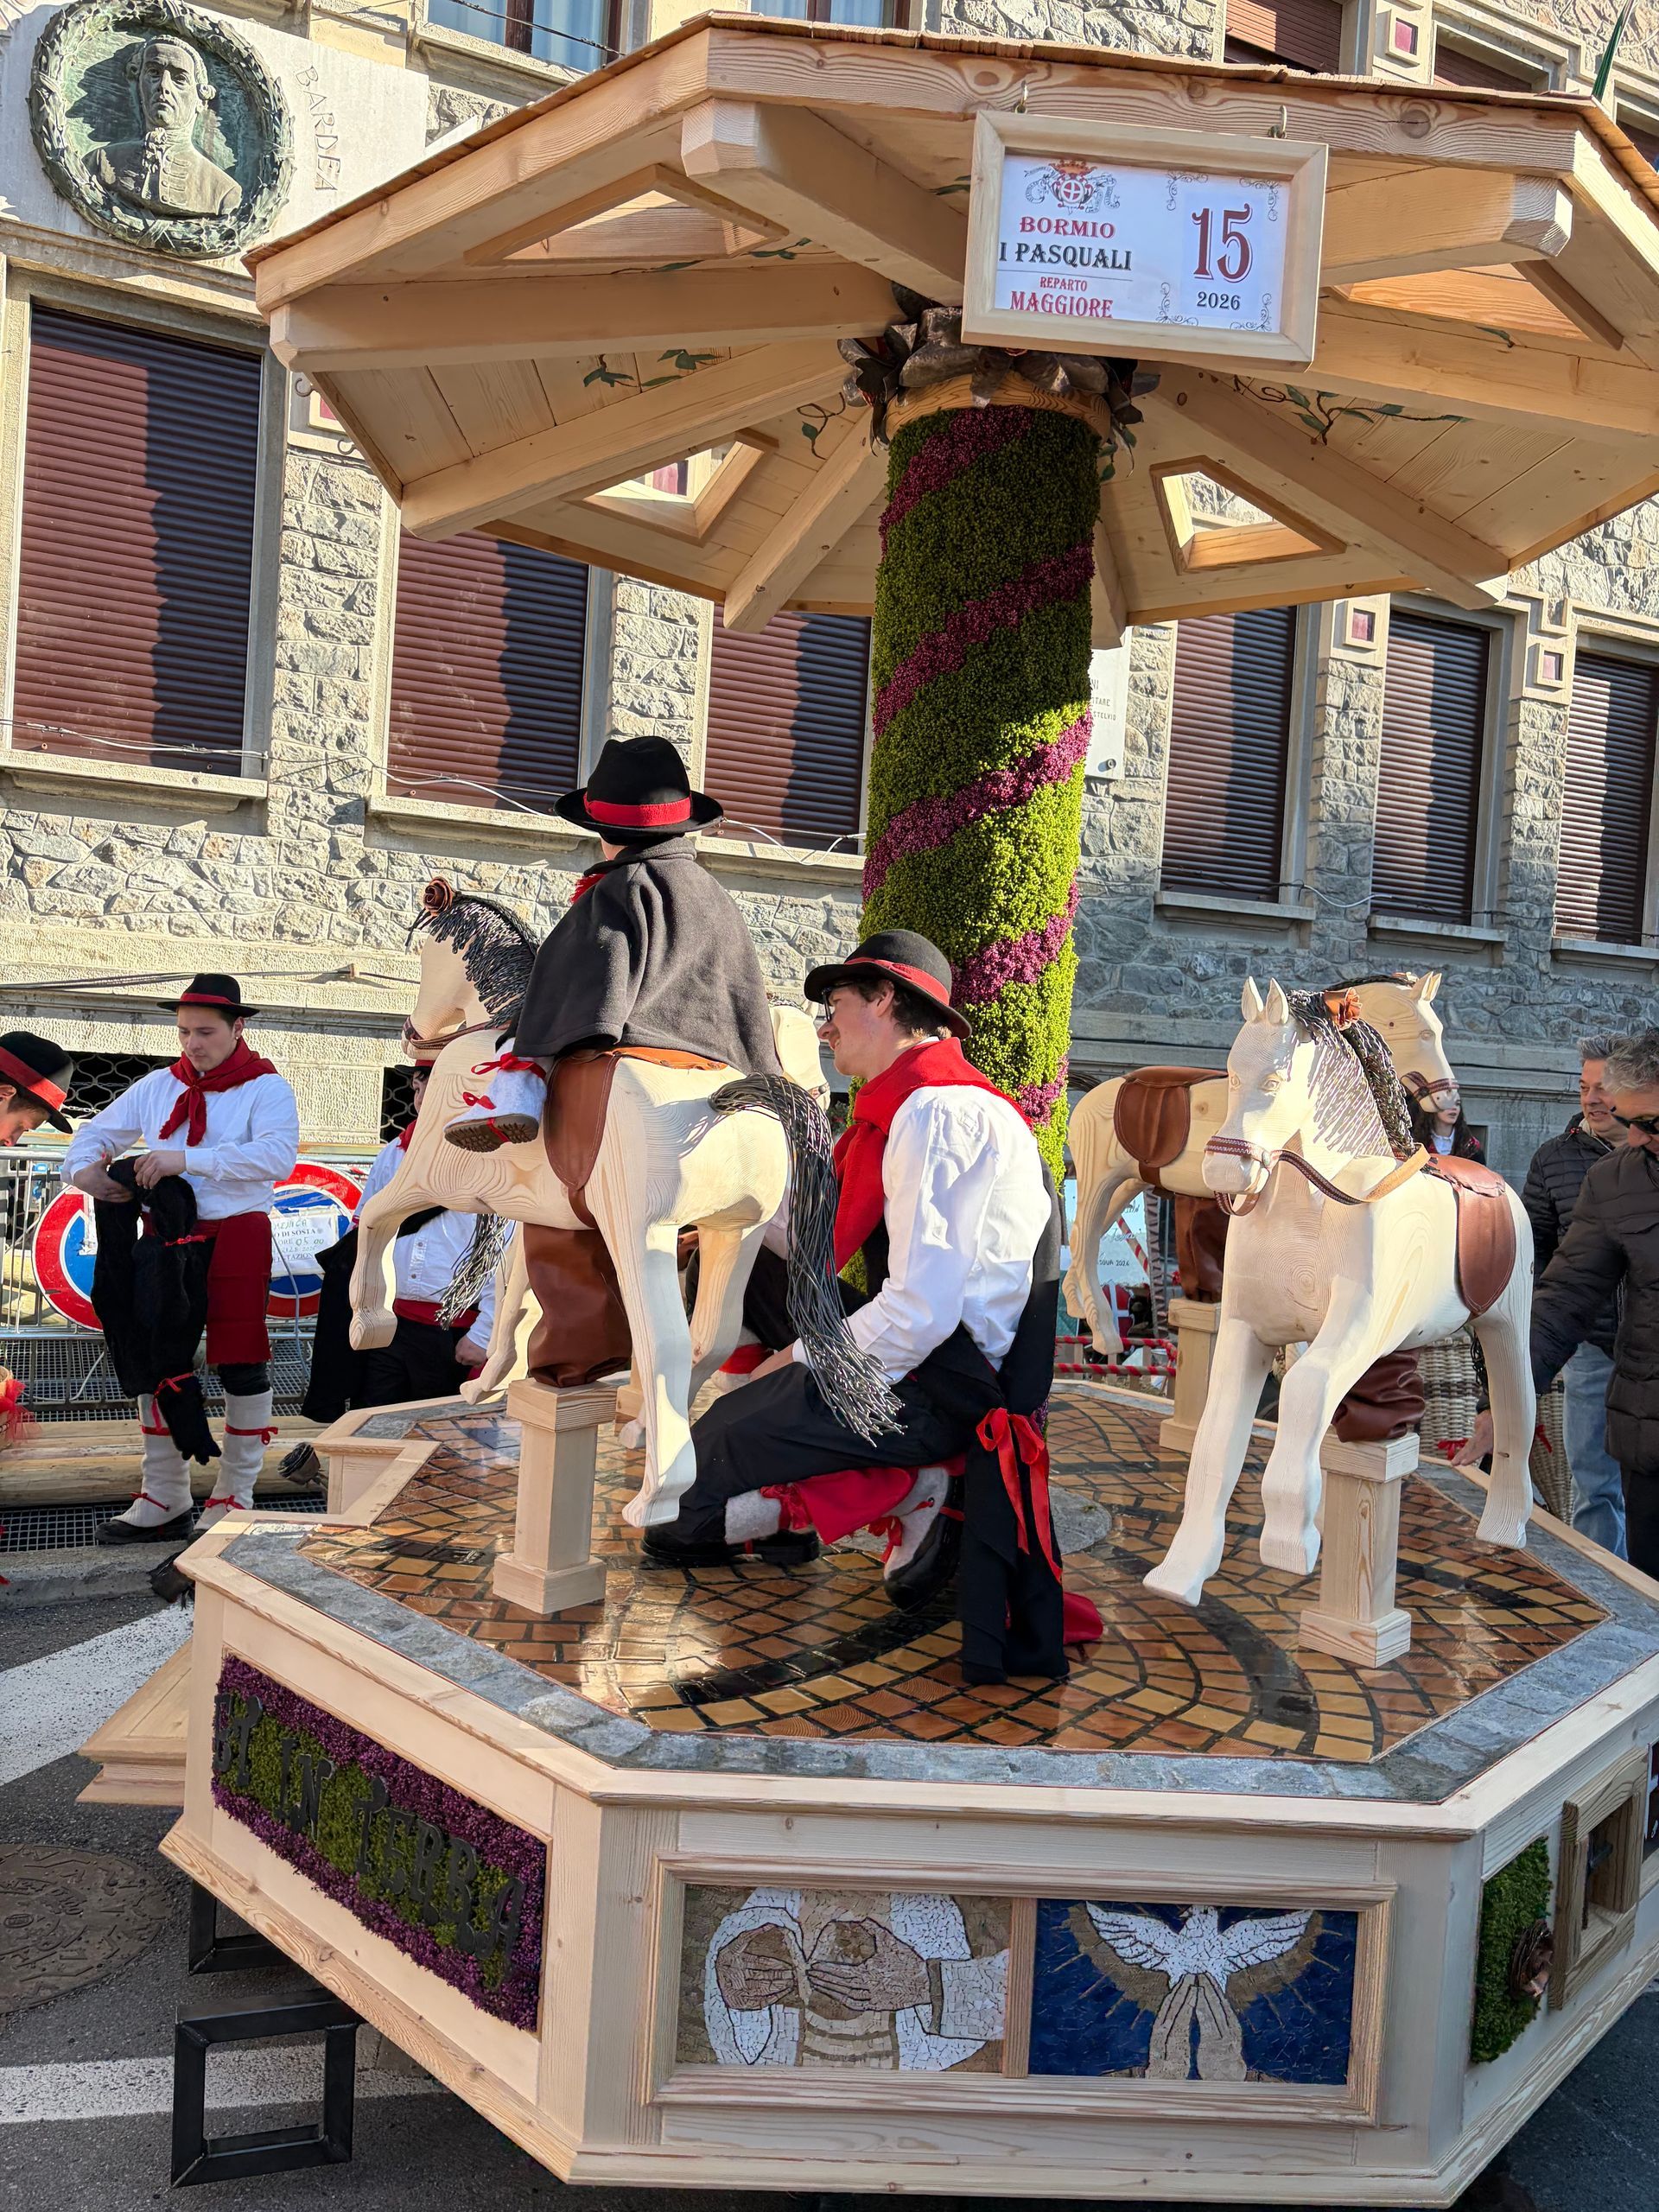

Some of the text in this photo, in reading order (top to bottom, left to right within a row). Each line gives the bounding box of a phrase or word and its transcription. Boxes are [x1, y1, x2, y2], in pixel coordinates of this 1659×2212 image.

[295, 65, 341, 191] BARDEA
[1020, 216, 1115, 239] BORMIO
[1000, 242, 1132, 271] I PASQUALI
[1192, 203, 1254, 284] 15
[1039, 276, 1088, 292] REPARTO
[1010, 290, 1114, 319] MAGGIORE
[1196, 291, 1242, 311] 2026
[1093, 711, 1116, 721] STELVIO
[274, 1737, 336, 1842] IN
[352, 1776, 528, 1986] TERRA
